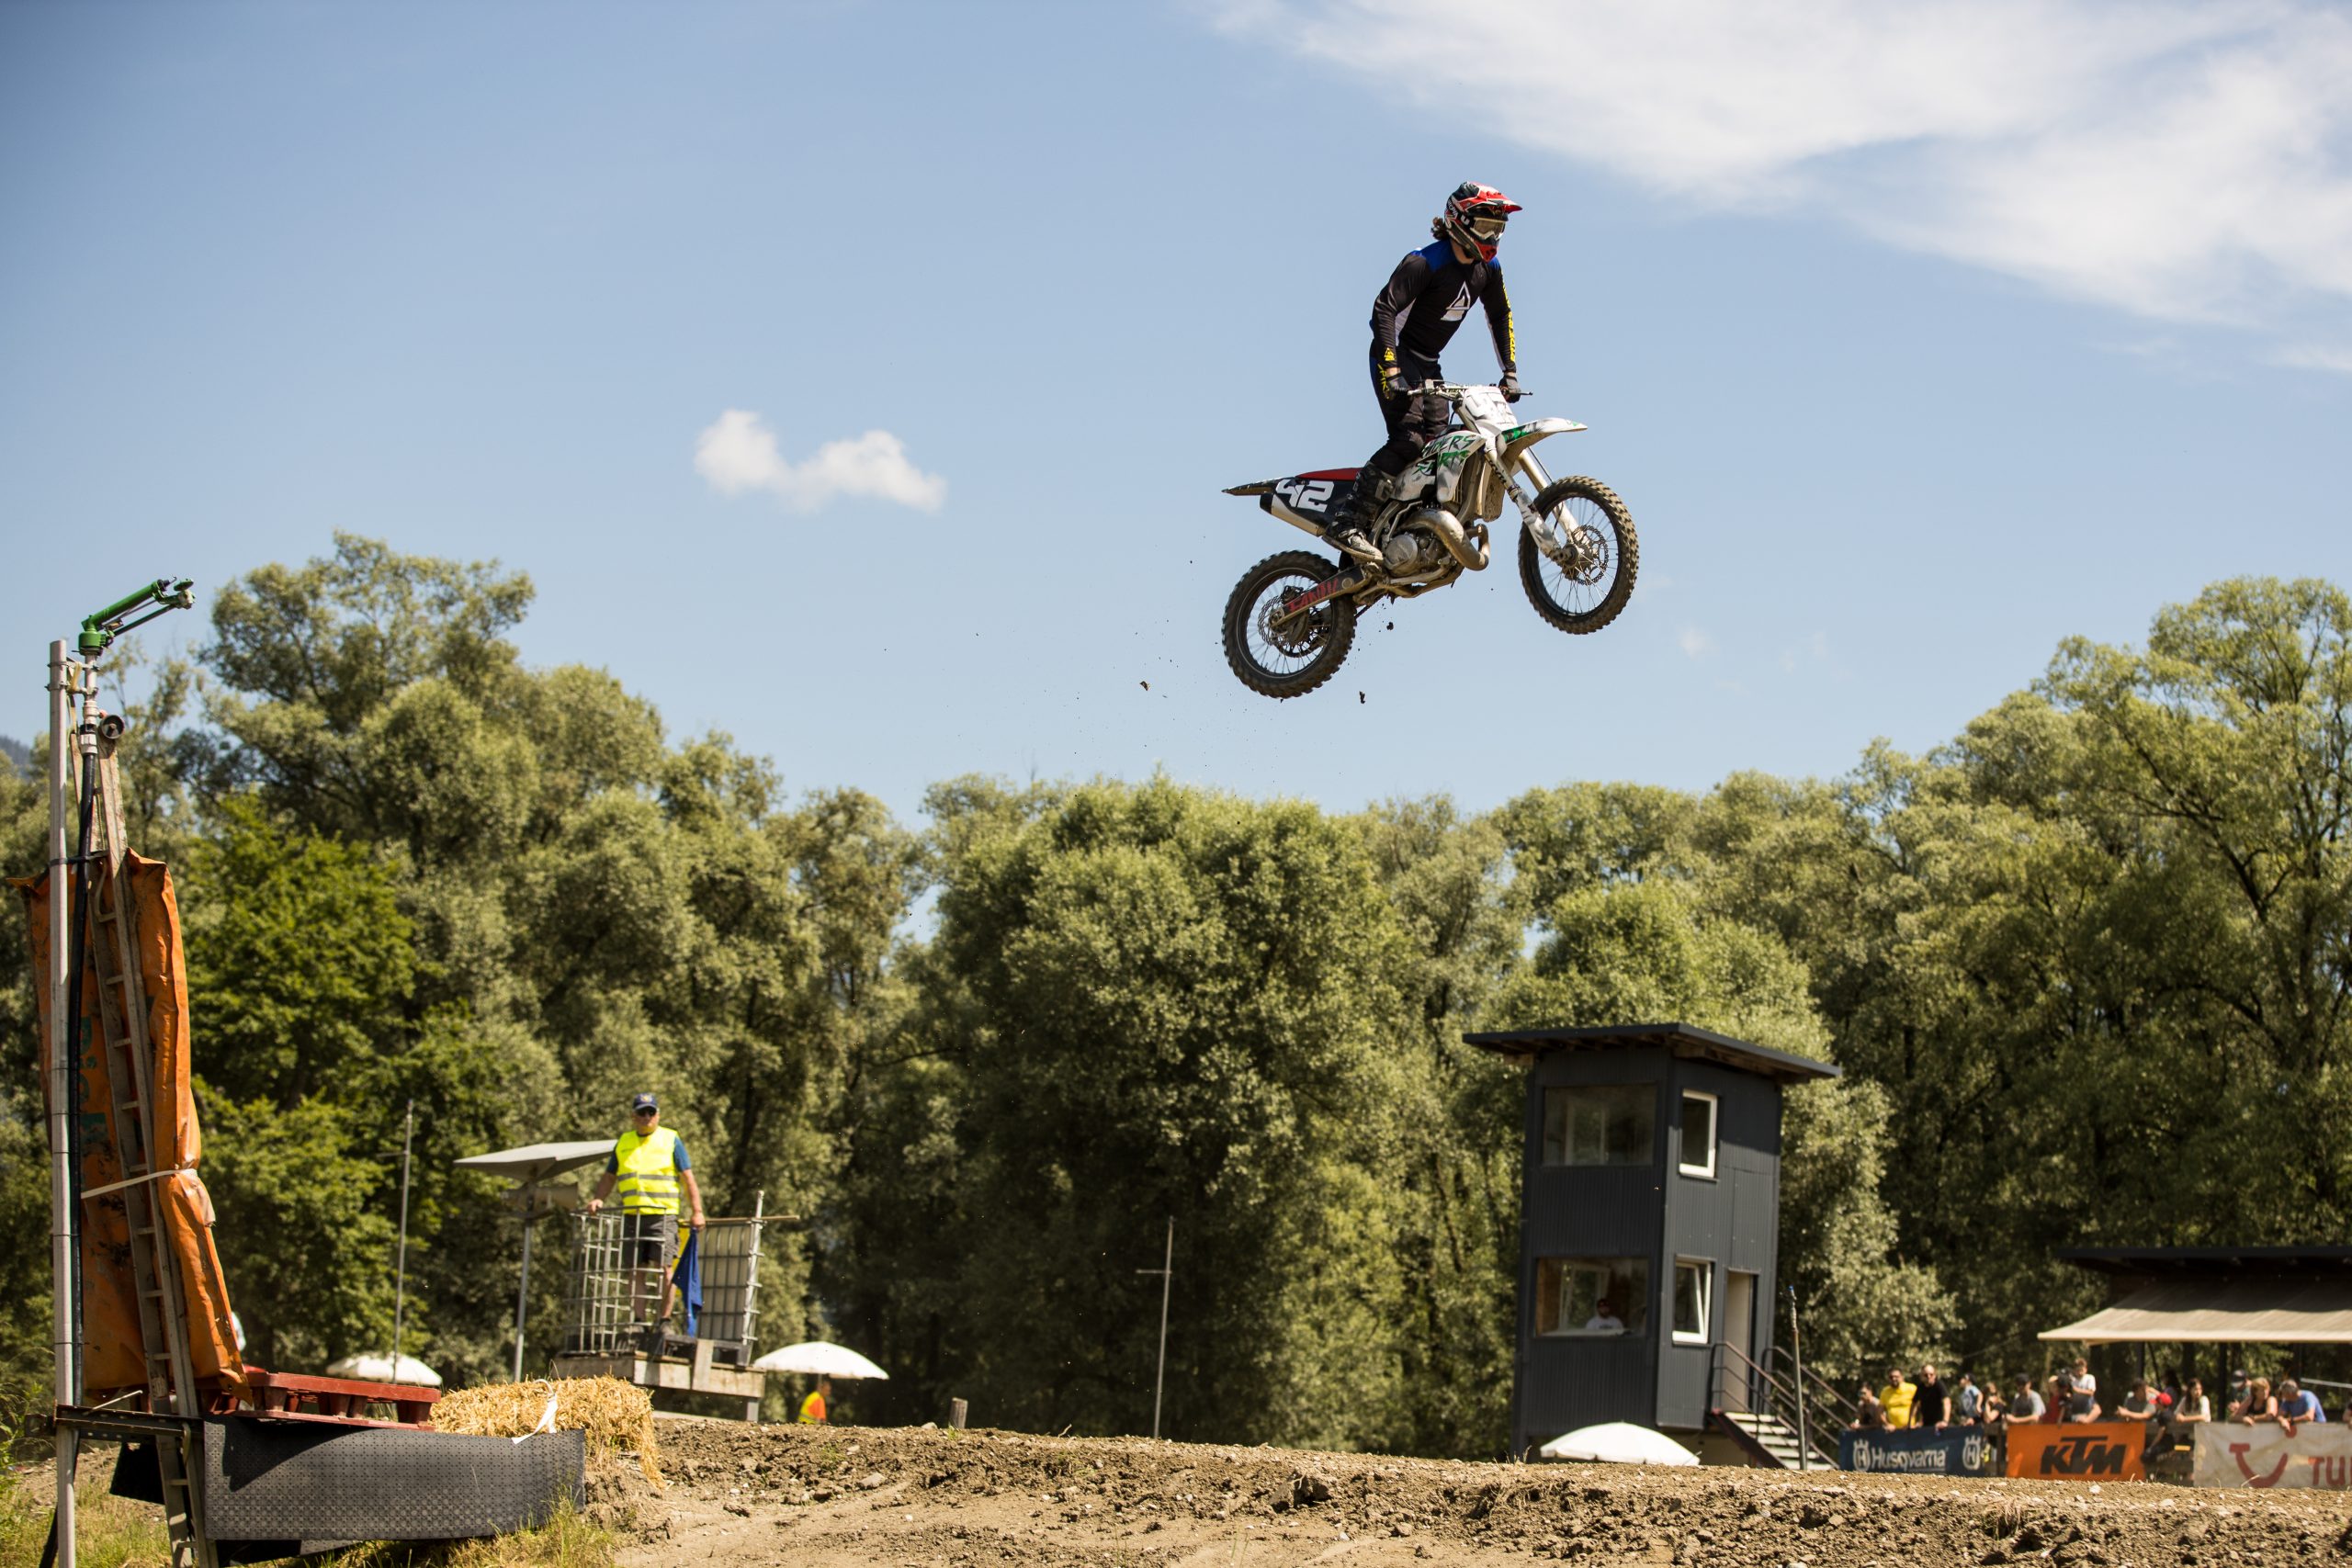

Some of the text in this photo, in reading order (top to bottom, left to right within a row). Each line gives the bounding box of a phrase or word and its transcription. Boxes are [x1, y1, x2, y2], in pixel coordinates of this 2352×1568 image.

[1871, 1447, 1947, 1471] Husqvarna
[2040, 1436, 2128, 1475] KTM
[2308, 1456, 2352, 1486] TU
